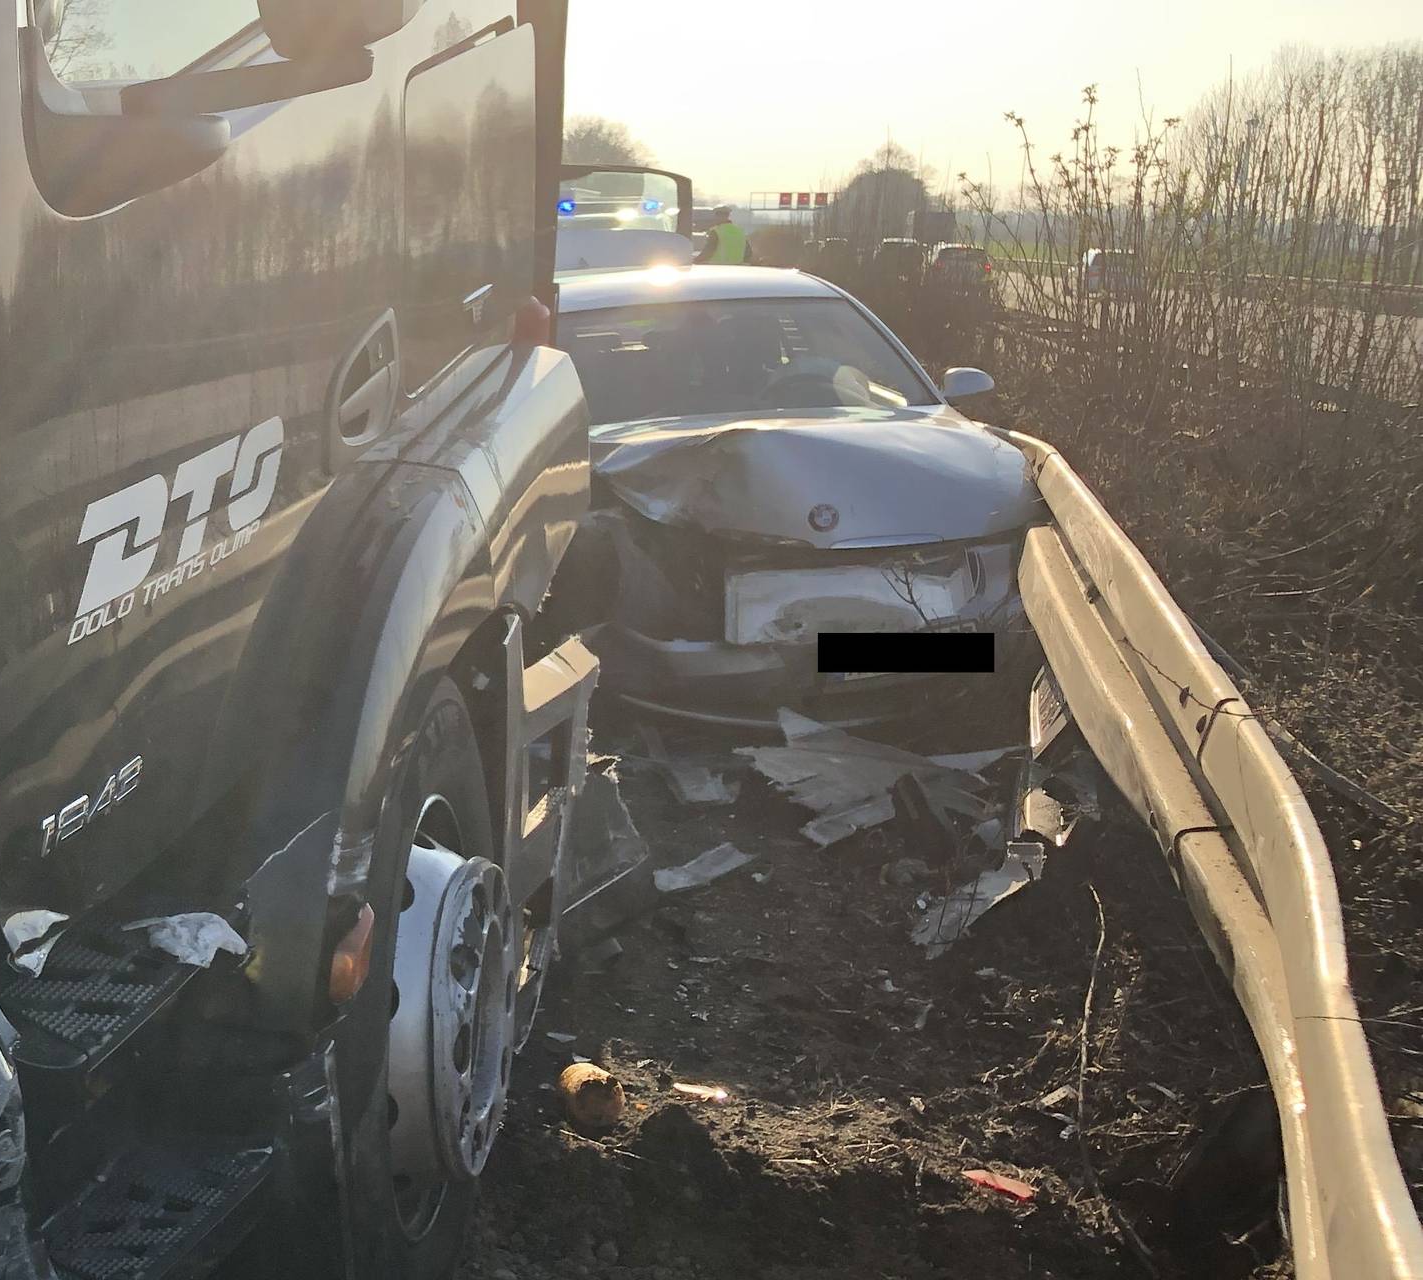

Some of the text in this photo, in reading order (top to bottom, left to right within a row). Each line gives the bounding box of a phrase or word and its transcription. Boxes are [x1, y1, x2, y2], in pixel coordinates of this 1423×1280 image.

[67, 519, 261, 646] DOLO TRANS OLIMP
